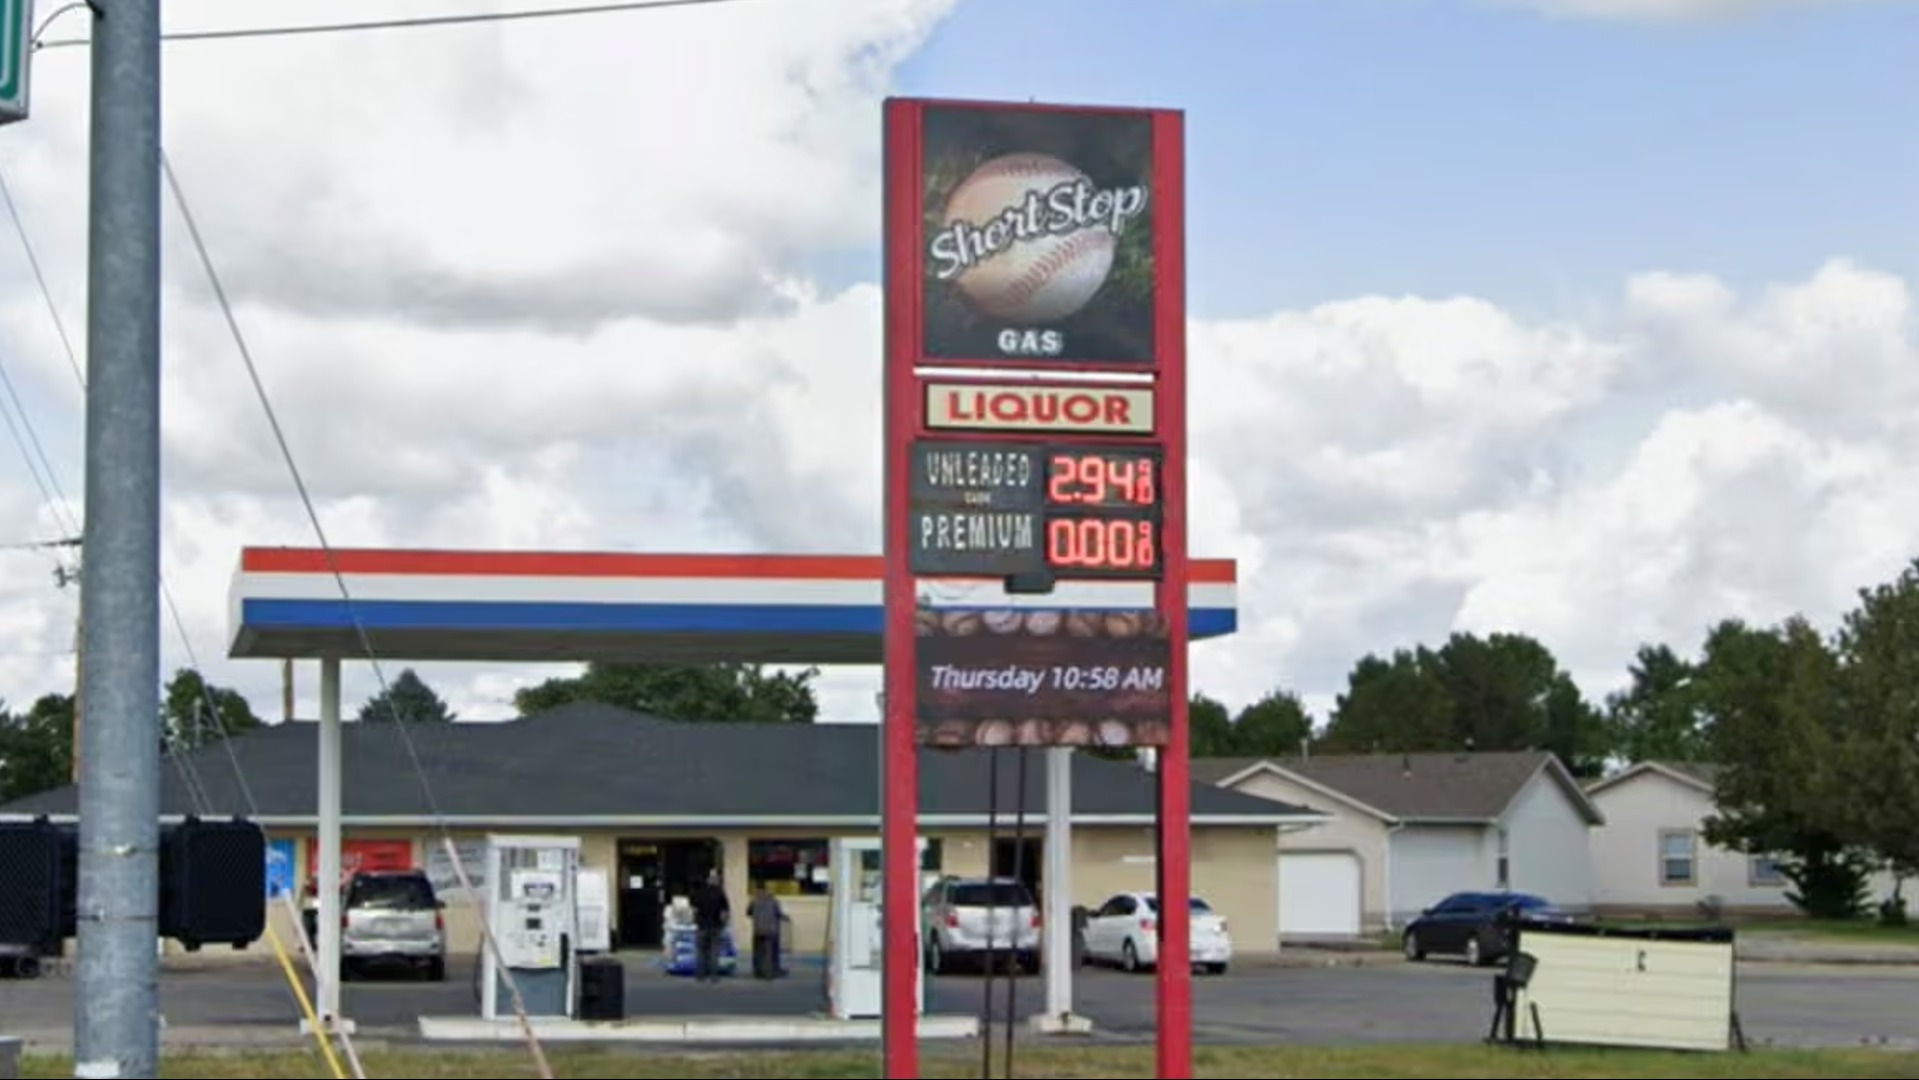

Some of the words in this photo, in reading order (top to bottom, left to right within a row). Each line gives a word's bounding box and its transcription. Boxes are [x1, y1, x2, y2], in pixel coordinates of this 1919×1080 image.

[931, 188, 1040, 278] Short
[1047, 176, 1145, 233] Stop
[998, 328, 1061, 355] GAS
[948, 392, 1130, 424] LIQUOR
[926, 452, 1030, 486] UNLEADED
[921, 514, 1033, 549] PREMIUM
[931, 665, 1046, 693] Thursday
[1053, 666, 1118, 690] 10:58
[1122, 667, 1163, 690] AM
